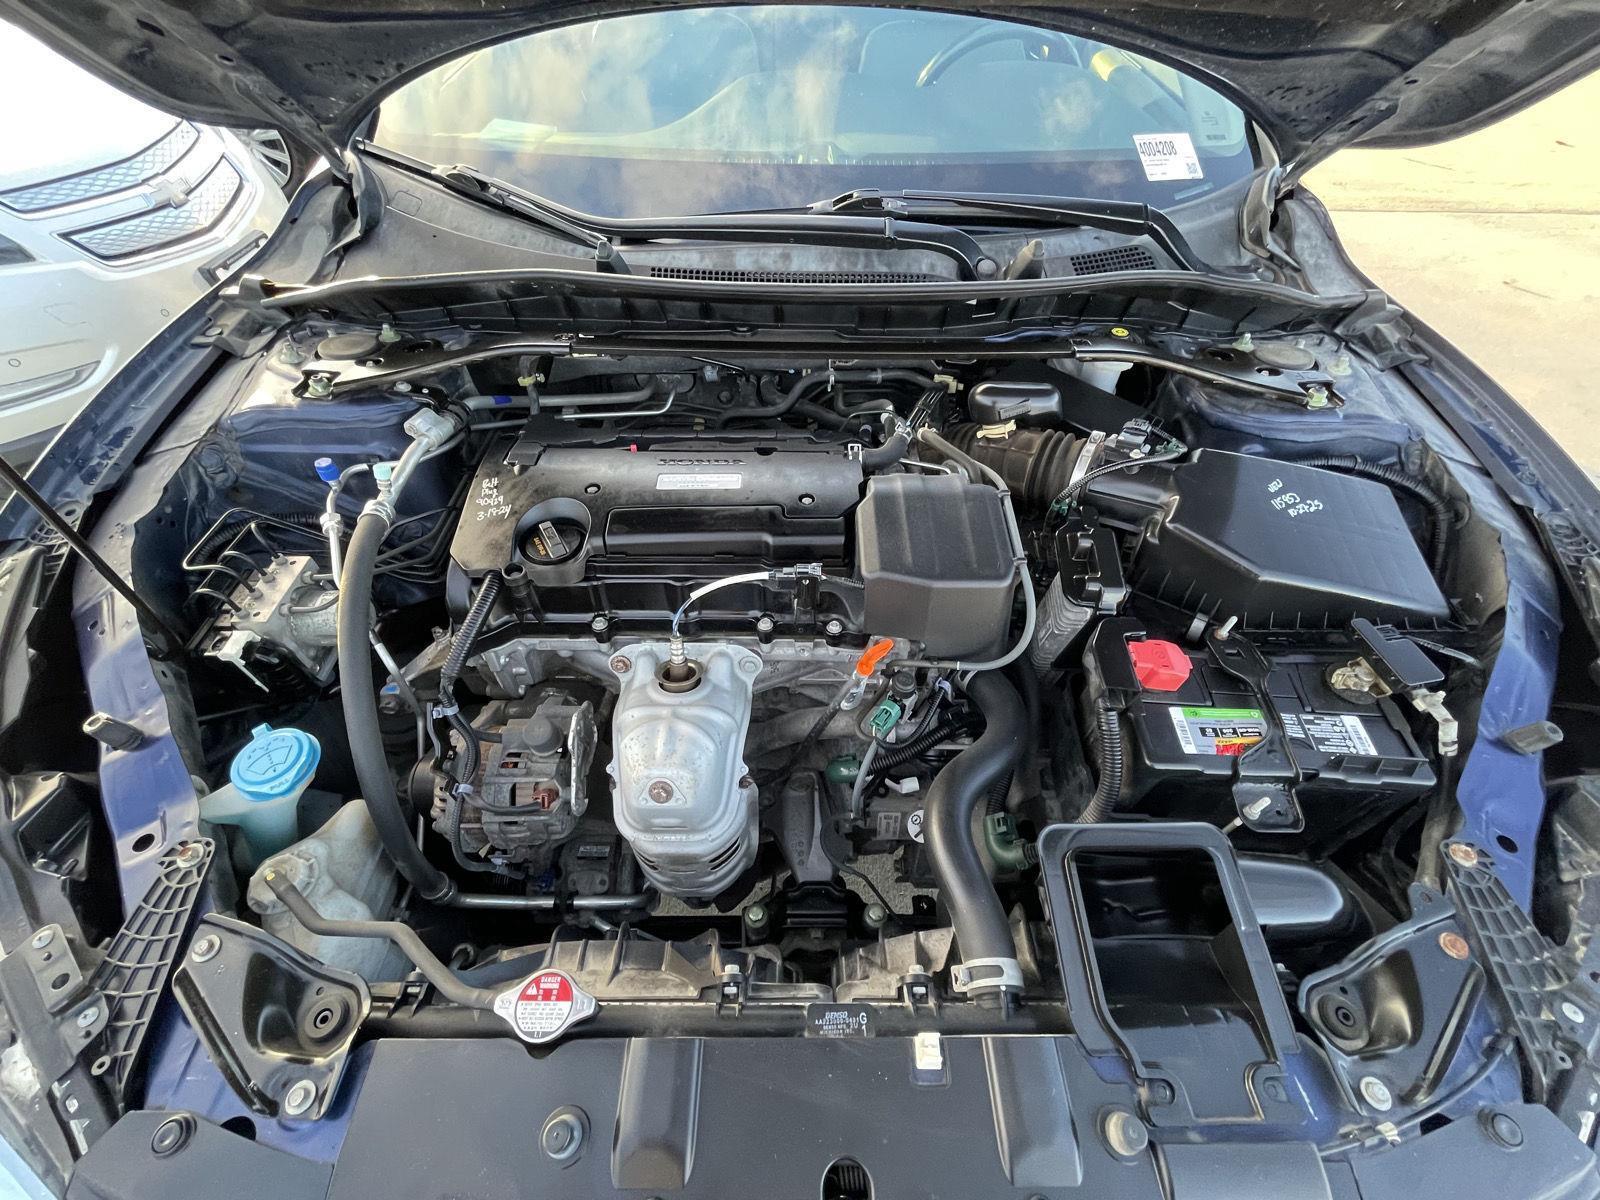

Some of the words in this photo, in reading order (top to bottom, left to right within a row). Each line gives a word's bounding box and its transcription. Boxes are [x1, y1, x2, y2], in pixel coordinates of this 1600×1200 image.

[1139, 140, 1178, 157] 4004208
[825, 1011, 848, 1019] DENSO
[859, 1012, 868, 1025] G
